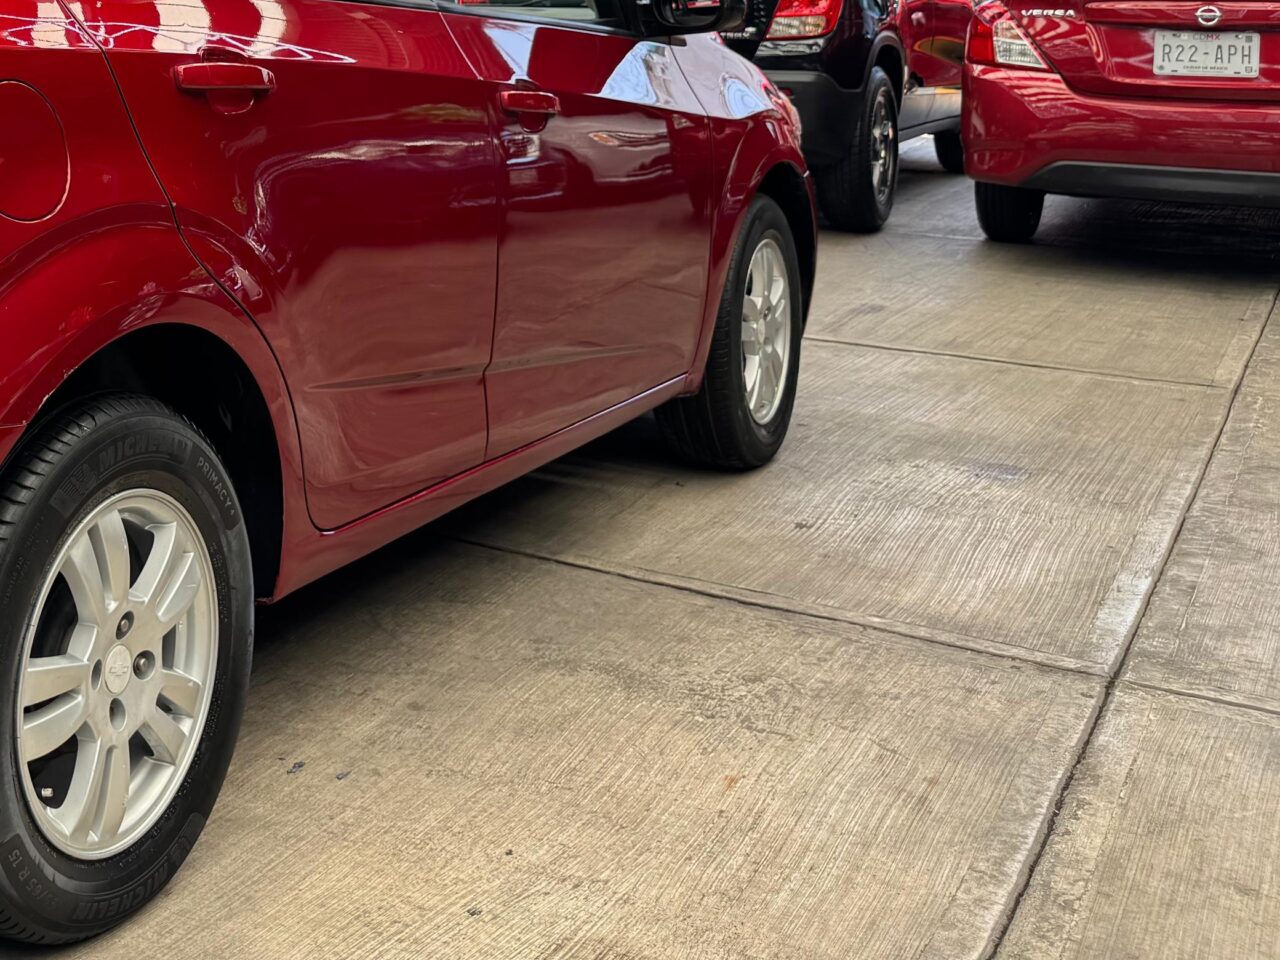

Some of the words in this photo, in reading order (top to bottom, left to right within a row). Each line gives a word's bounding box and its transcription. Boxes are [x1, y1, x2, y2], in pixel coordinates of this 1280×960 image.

[1193, 33, 1221, 41] CDMX
[1162, 43, 1252, 65] R22-APH
[196, 456, 233, 508] PRIMACY
[8, 848, 23, 868] 15
[18, 866, 31, 881] R
[72, 860, 169, 921] MICHELIN
